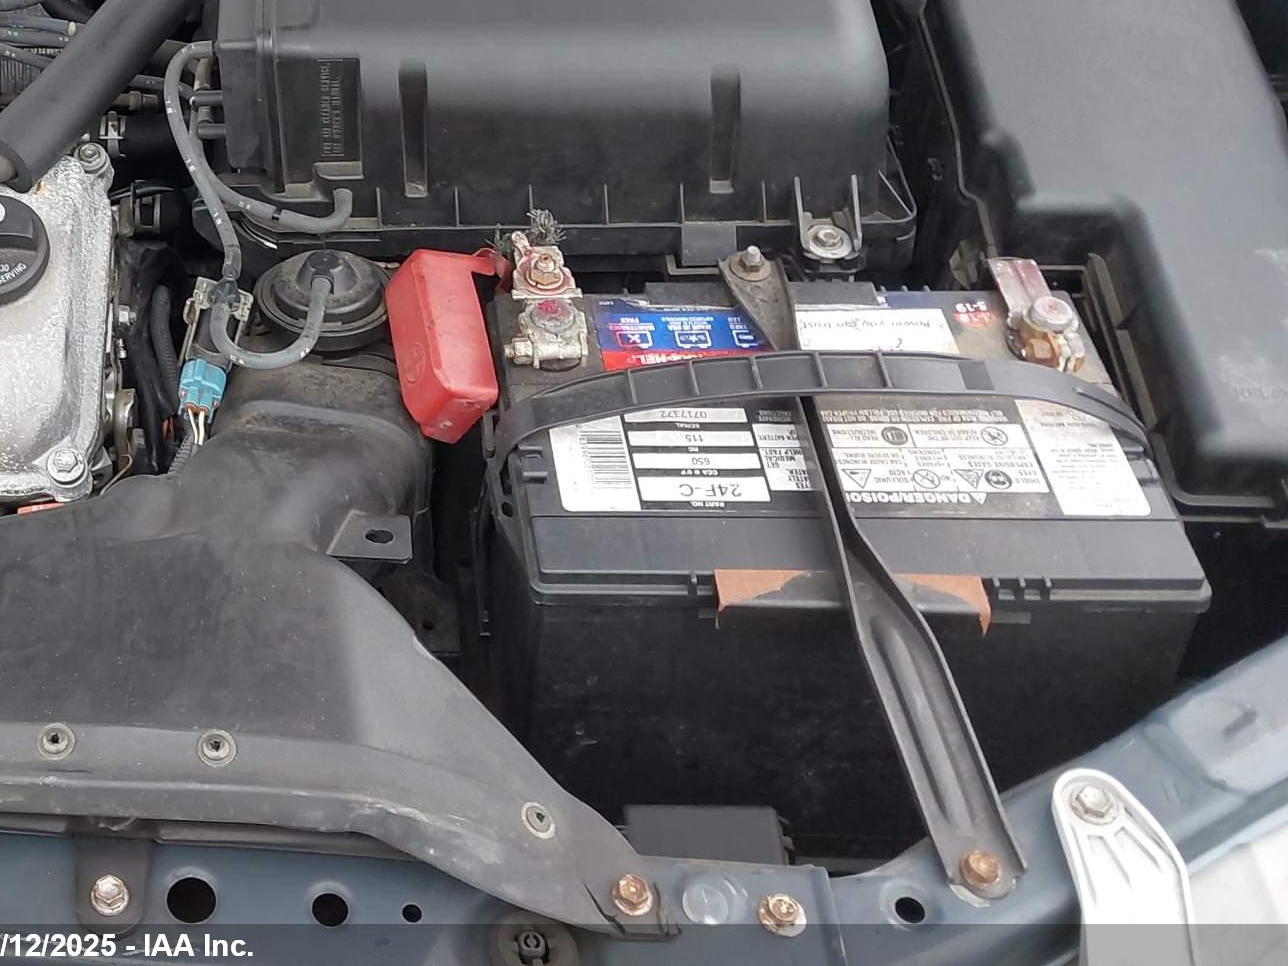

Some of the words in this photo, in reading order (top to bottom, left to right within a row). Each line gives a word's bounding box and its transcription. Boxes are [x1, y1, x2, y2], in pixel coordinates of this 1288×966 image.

[684, 434, 704, 443] 115
[691, 457, 711, 466] 650
[679, 483, 742, 497] 24F-C
[845, 491, 971, 503] DANGER/POISO
